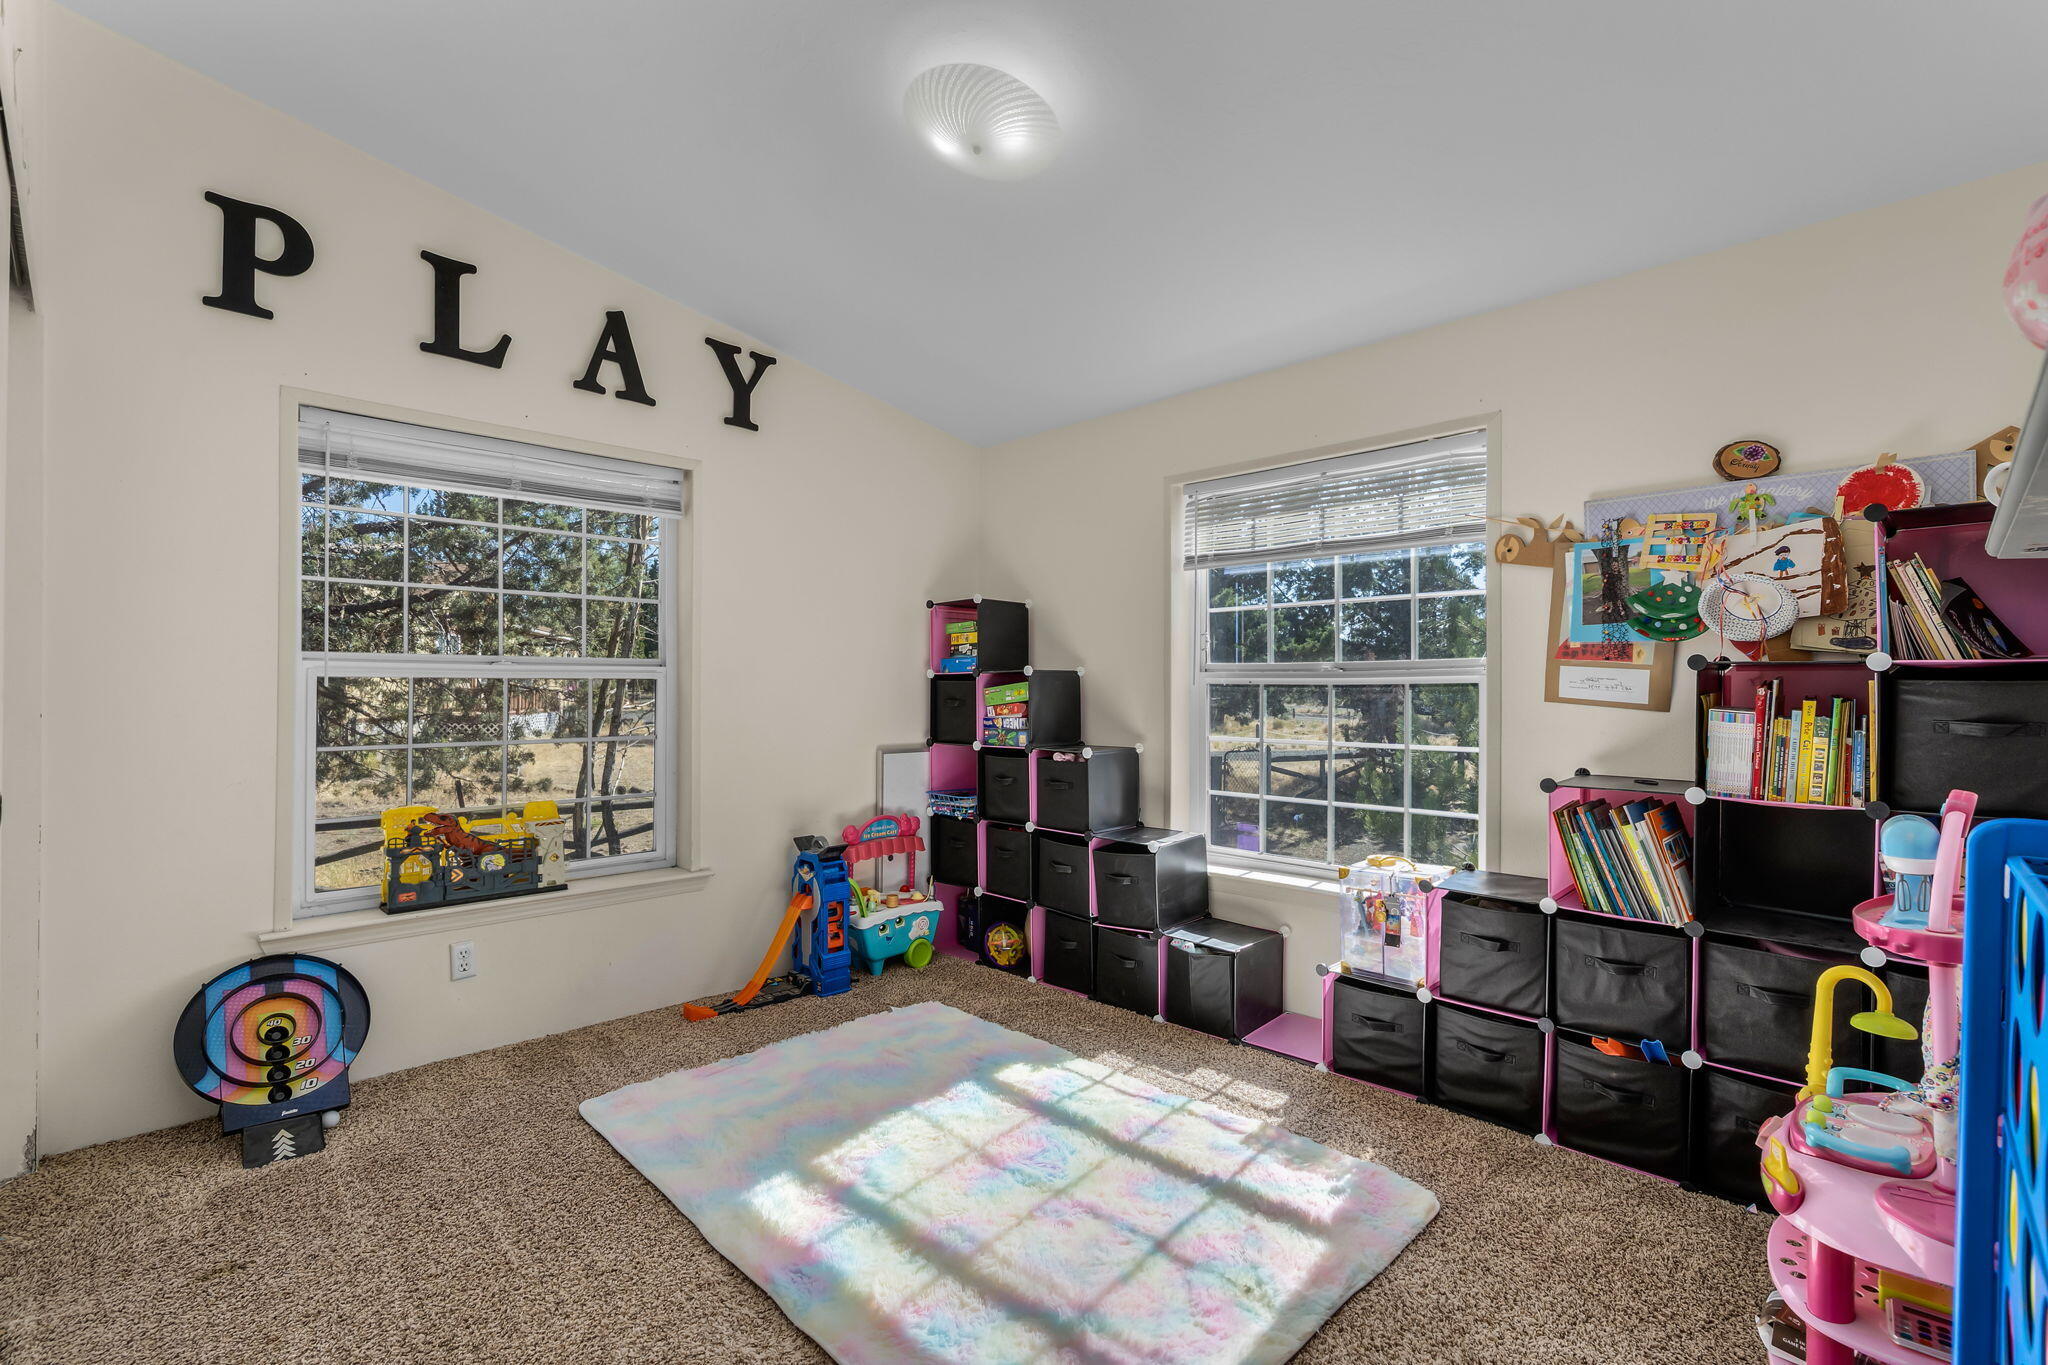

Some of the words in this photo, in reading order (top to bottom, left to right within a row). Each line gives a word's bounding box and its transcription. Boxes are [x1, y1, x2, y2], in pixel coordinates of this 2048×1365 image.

[1704, 496, 1728, 510] the
[1759, 485, 1815, 501] gallery
[1804, 722, 1813, 735] Pete
[1803, 739, 1811, 751] Cat
[266, 1018, 283, 1027] 40
[293, 1035, 312, 1046] 30
[295, 1058, 316, 1070] 20
[300, 1077, 319, 1090] 10
[1782, 1337, 1799, 1348] GAME
